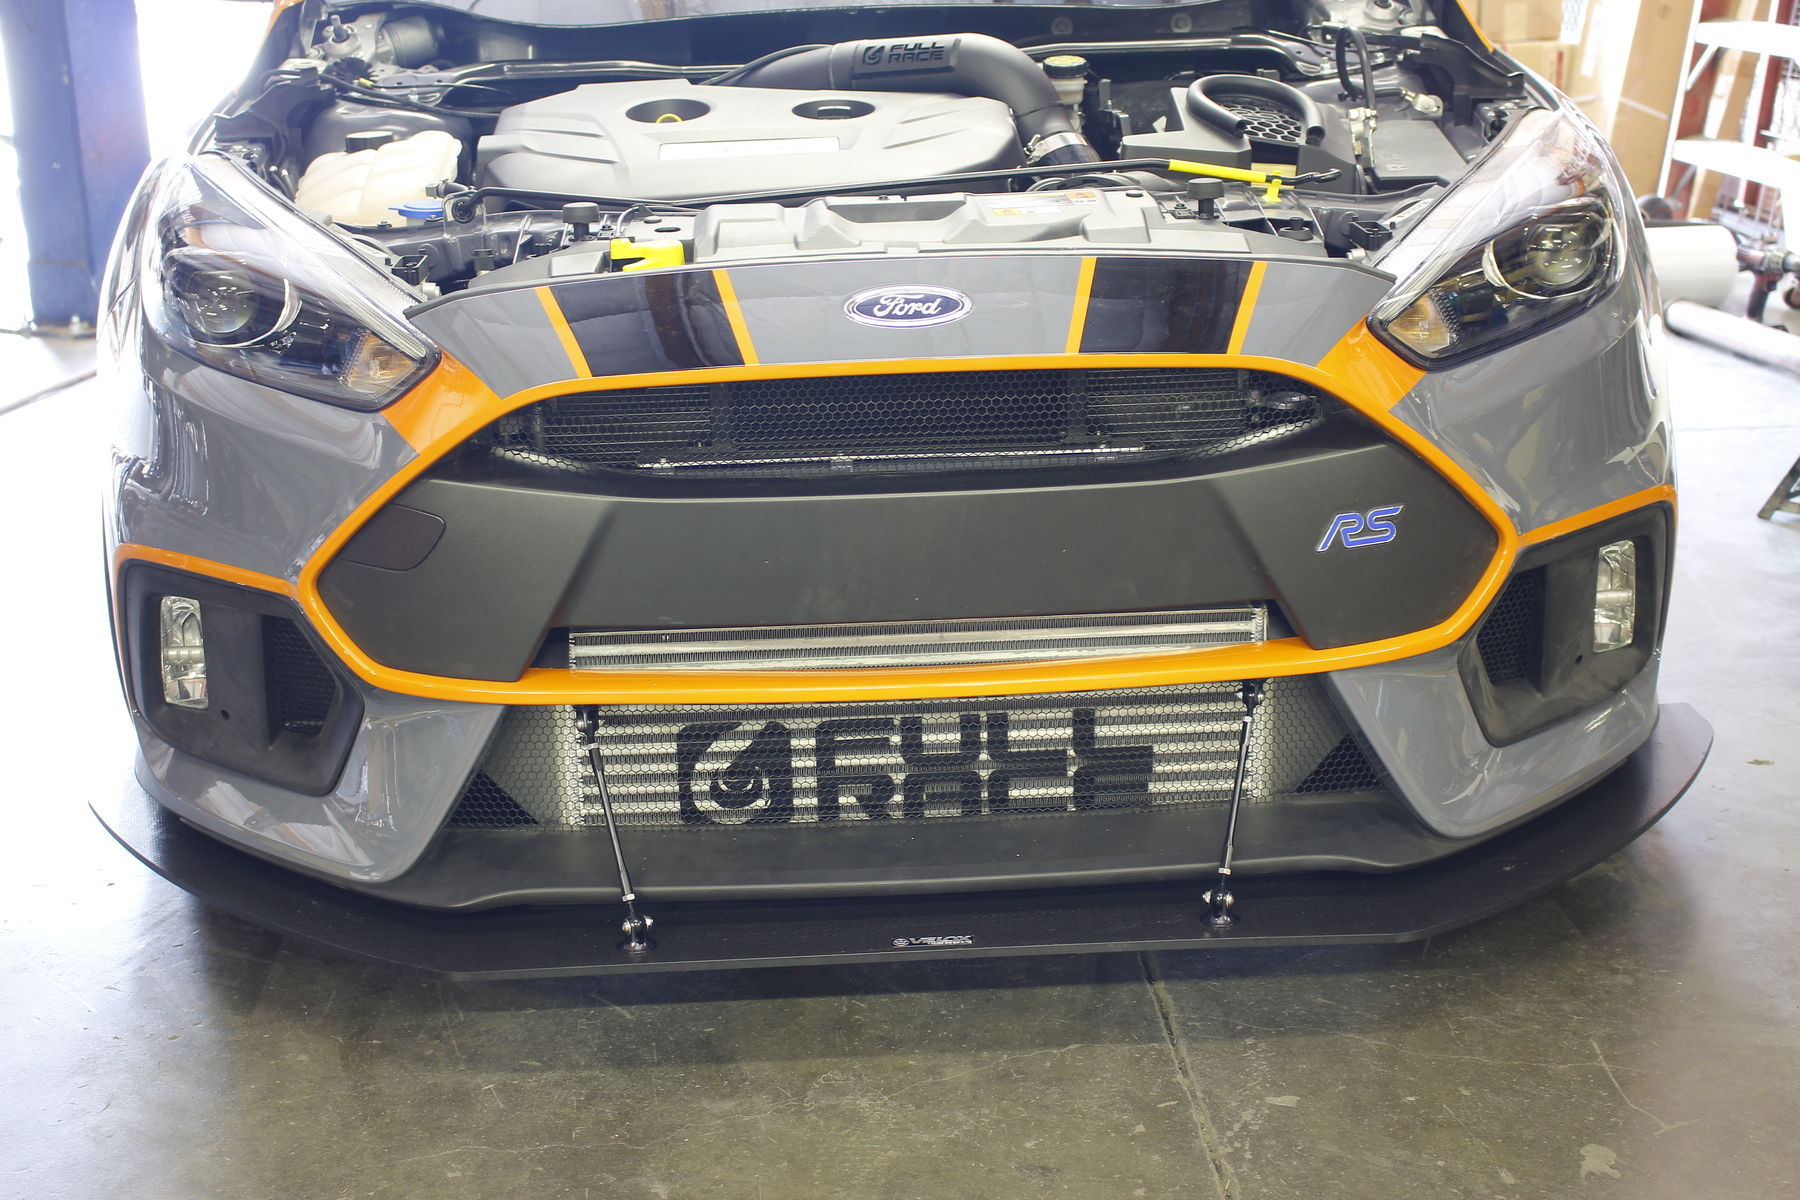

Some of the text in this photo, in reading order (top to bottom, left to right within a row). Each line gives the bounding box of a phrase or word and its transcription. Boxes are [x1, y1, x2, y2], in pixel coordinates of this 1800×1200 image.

[887, 50, 944, 64] RACE
[889, 42, 945, 52] FULL
[873, 294, 942, 317] Ford
[1316, 505, 1404, 552] RS
[815, 708, 1153, 774] FULL
[816, 764, 1153, 822] RACE
